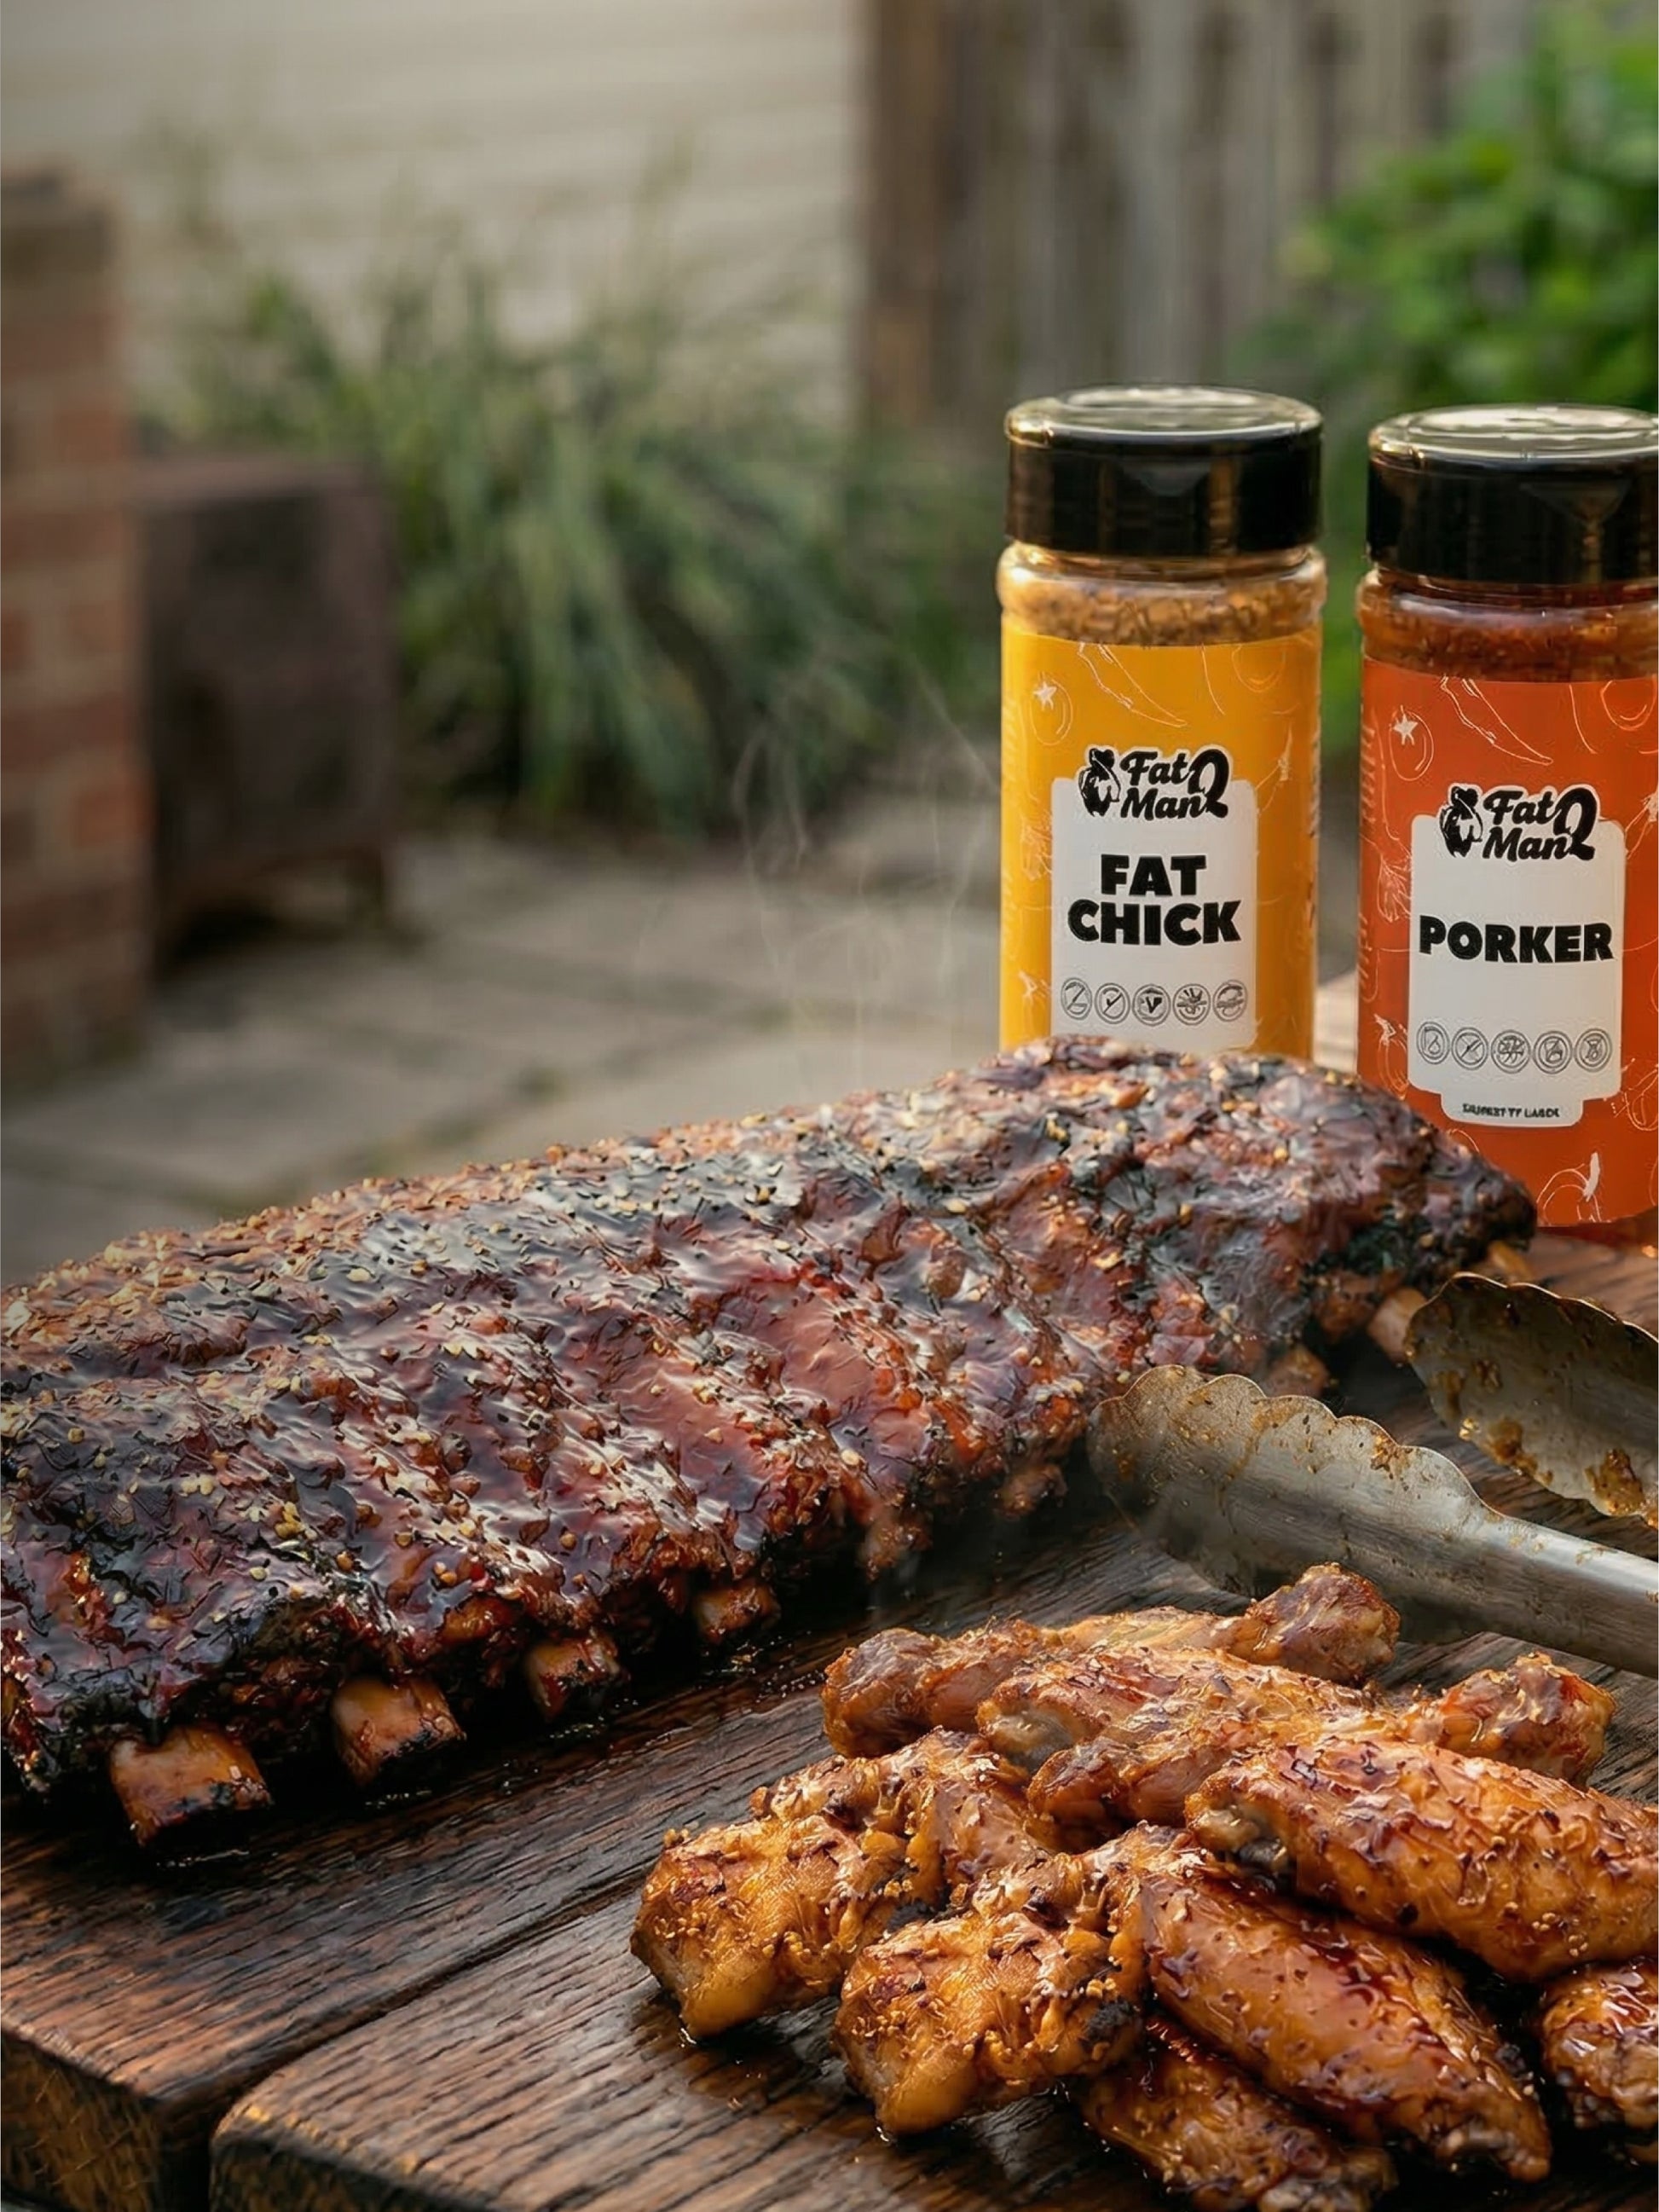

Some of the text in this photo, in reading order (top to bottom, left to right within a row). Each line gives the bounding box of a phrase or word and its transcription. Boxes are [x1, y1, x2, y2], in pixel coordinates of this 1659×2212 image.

[1120, 751, 1188, 785] Fat
[1120, 749, 1229, 820] Man Q
[1483, 790, 1553, 825] Fat
[1483, 787, 1599, 861] Man Q
[1101, 854, 1206, 896] FAT
[1068, 899, 1242, 946] CHICK
[1419, 915, 1614, 964] PORKER
